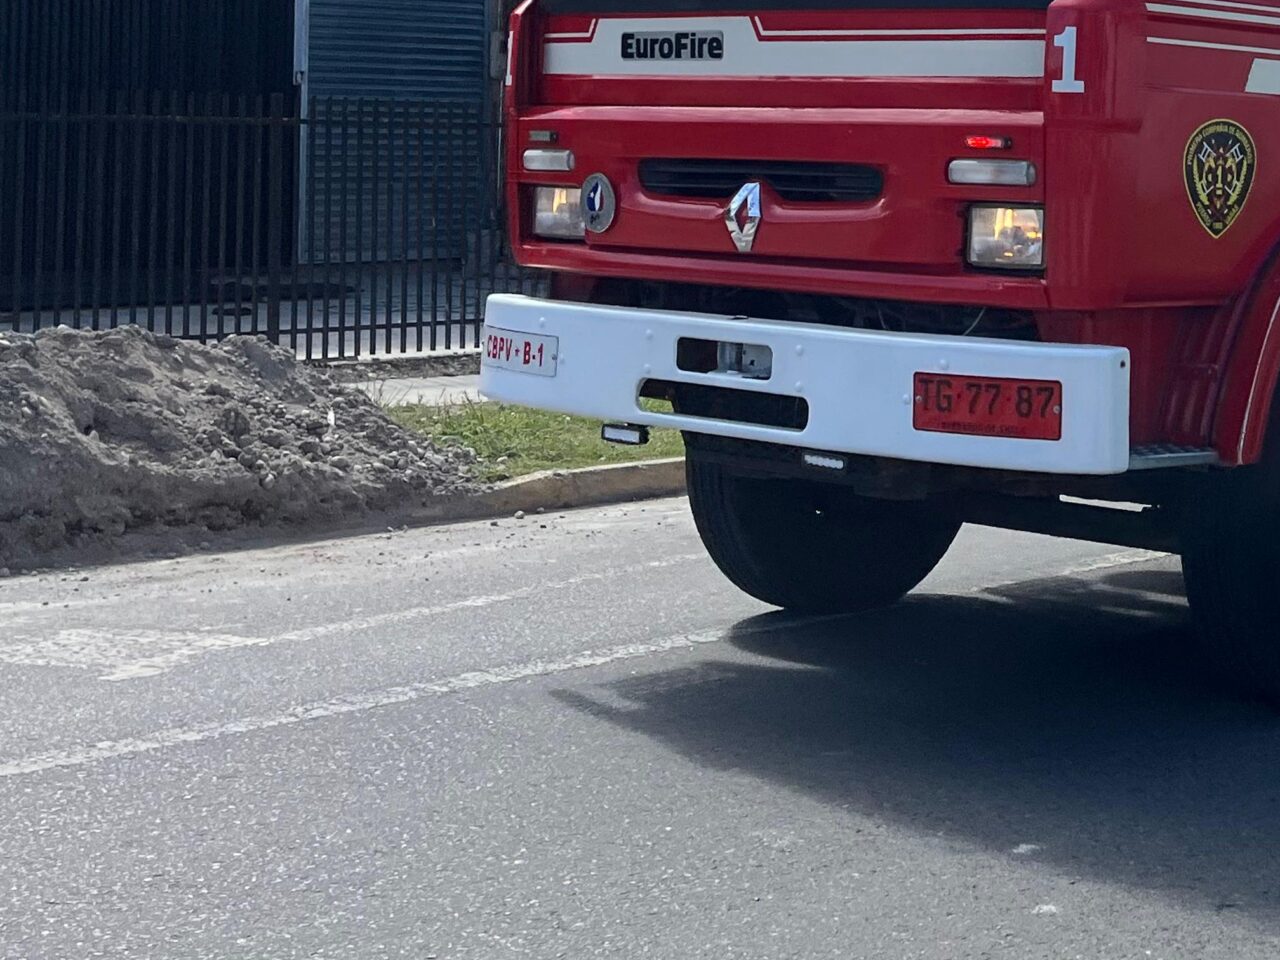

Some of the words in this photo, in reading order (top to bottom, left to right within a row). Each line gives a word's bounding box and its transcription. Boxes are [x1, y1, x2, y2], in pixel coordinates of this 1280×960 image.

[621, 32, 723, 59] EuroFire
[1051, 26, 1085, 93] 1
[487, 334, 513, 362] CBPV
